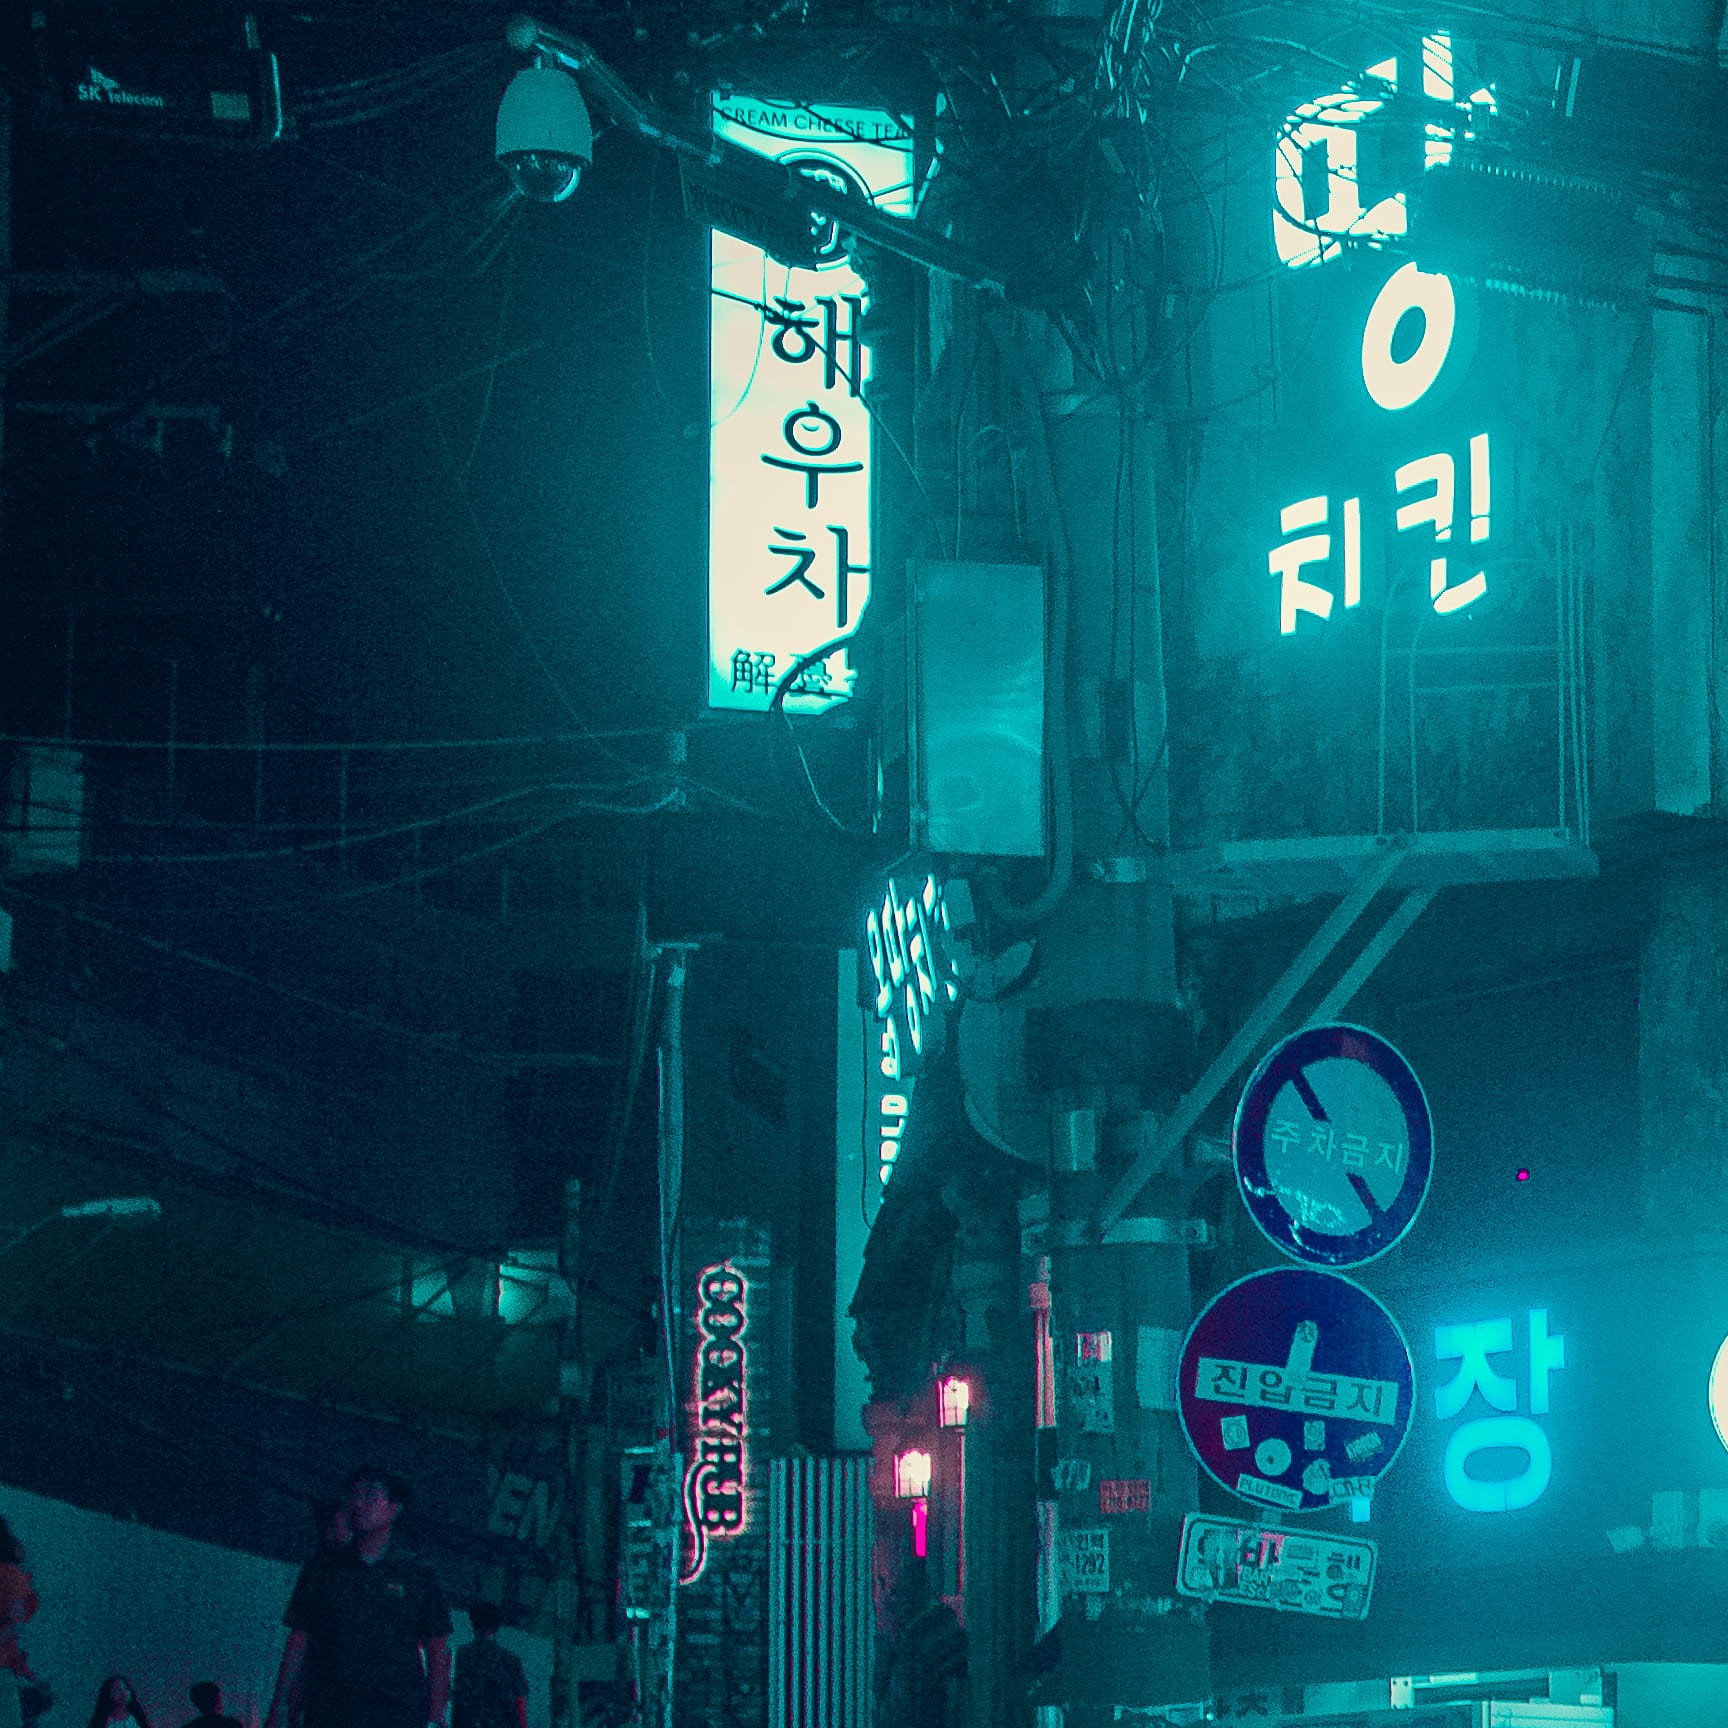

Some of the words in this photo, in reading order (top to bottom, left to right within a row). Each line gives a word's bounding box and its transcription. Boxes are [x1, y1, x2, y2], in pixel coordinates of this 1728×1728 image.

[720, 106, 788, 129] CREAM
[1271, 1119, 1403, 1175] 주차금지
[1210, 1360, 1384, 1419] 진입금지
